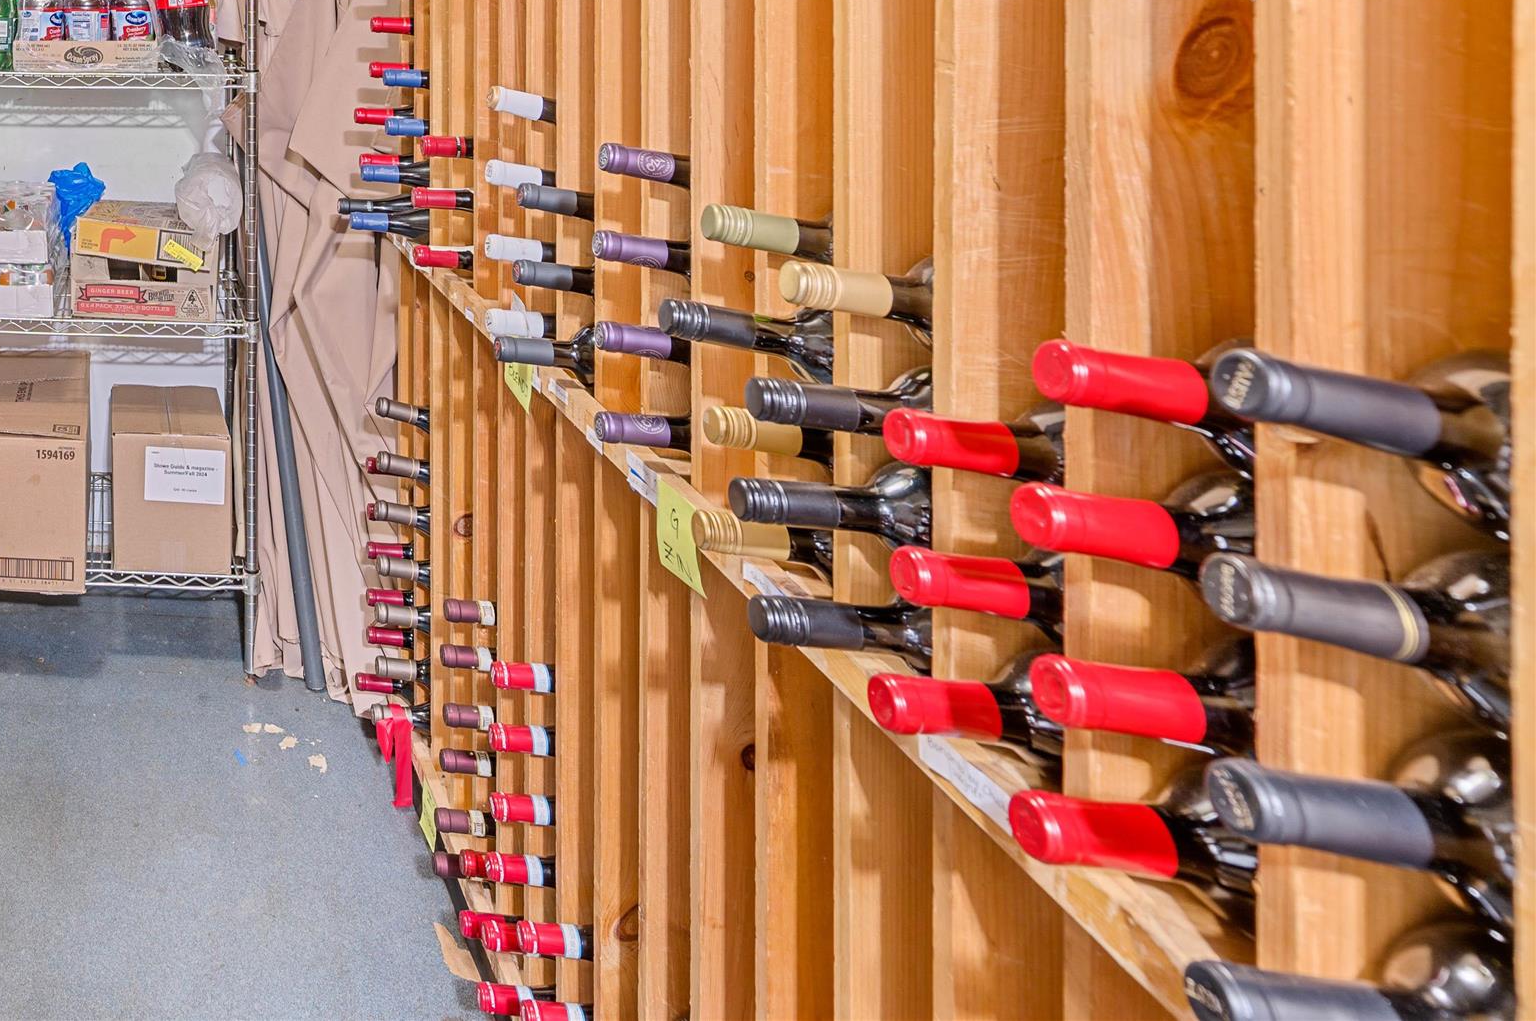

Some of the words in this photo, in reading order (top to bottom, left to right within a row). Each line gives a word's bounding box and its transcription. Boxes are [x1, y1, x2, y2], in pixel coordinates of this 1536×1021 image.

[66, 54, 83, 64] Ocean
[83, 54, 99, 64] Spray
[36, 449, 75, 460] 1594169
